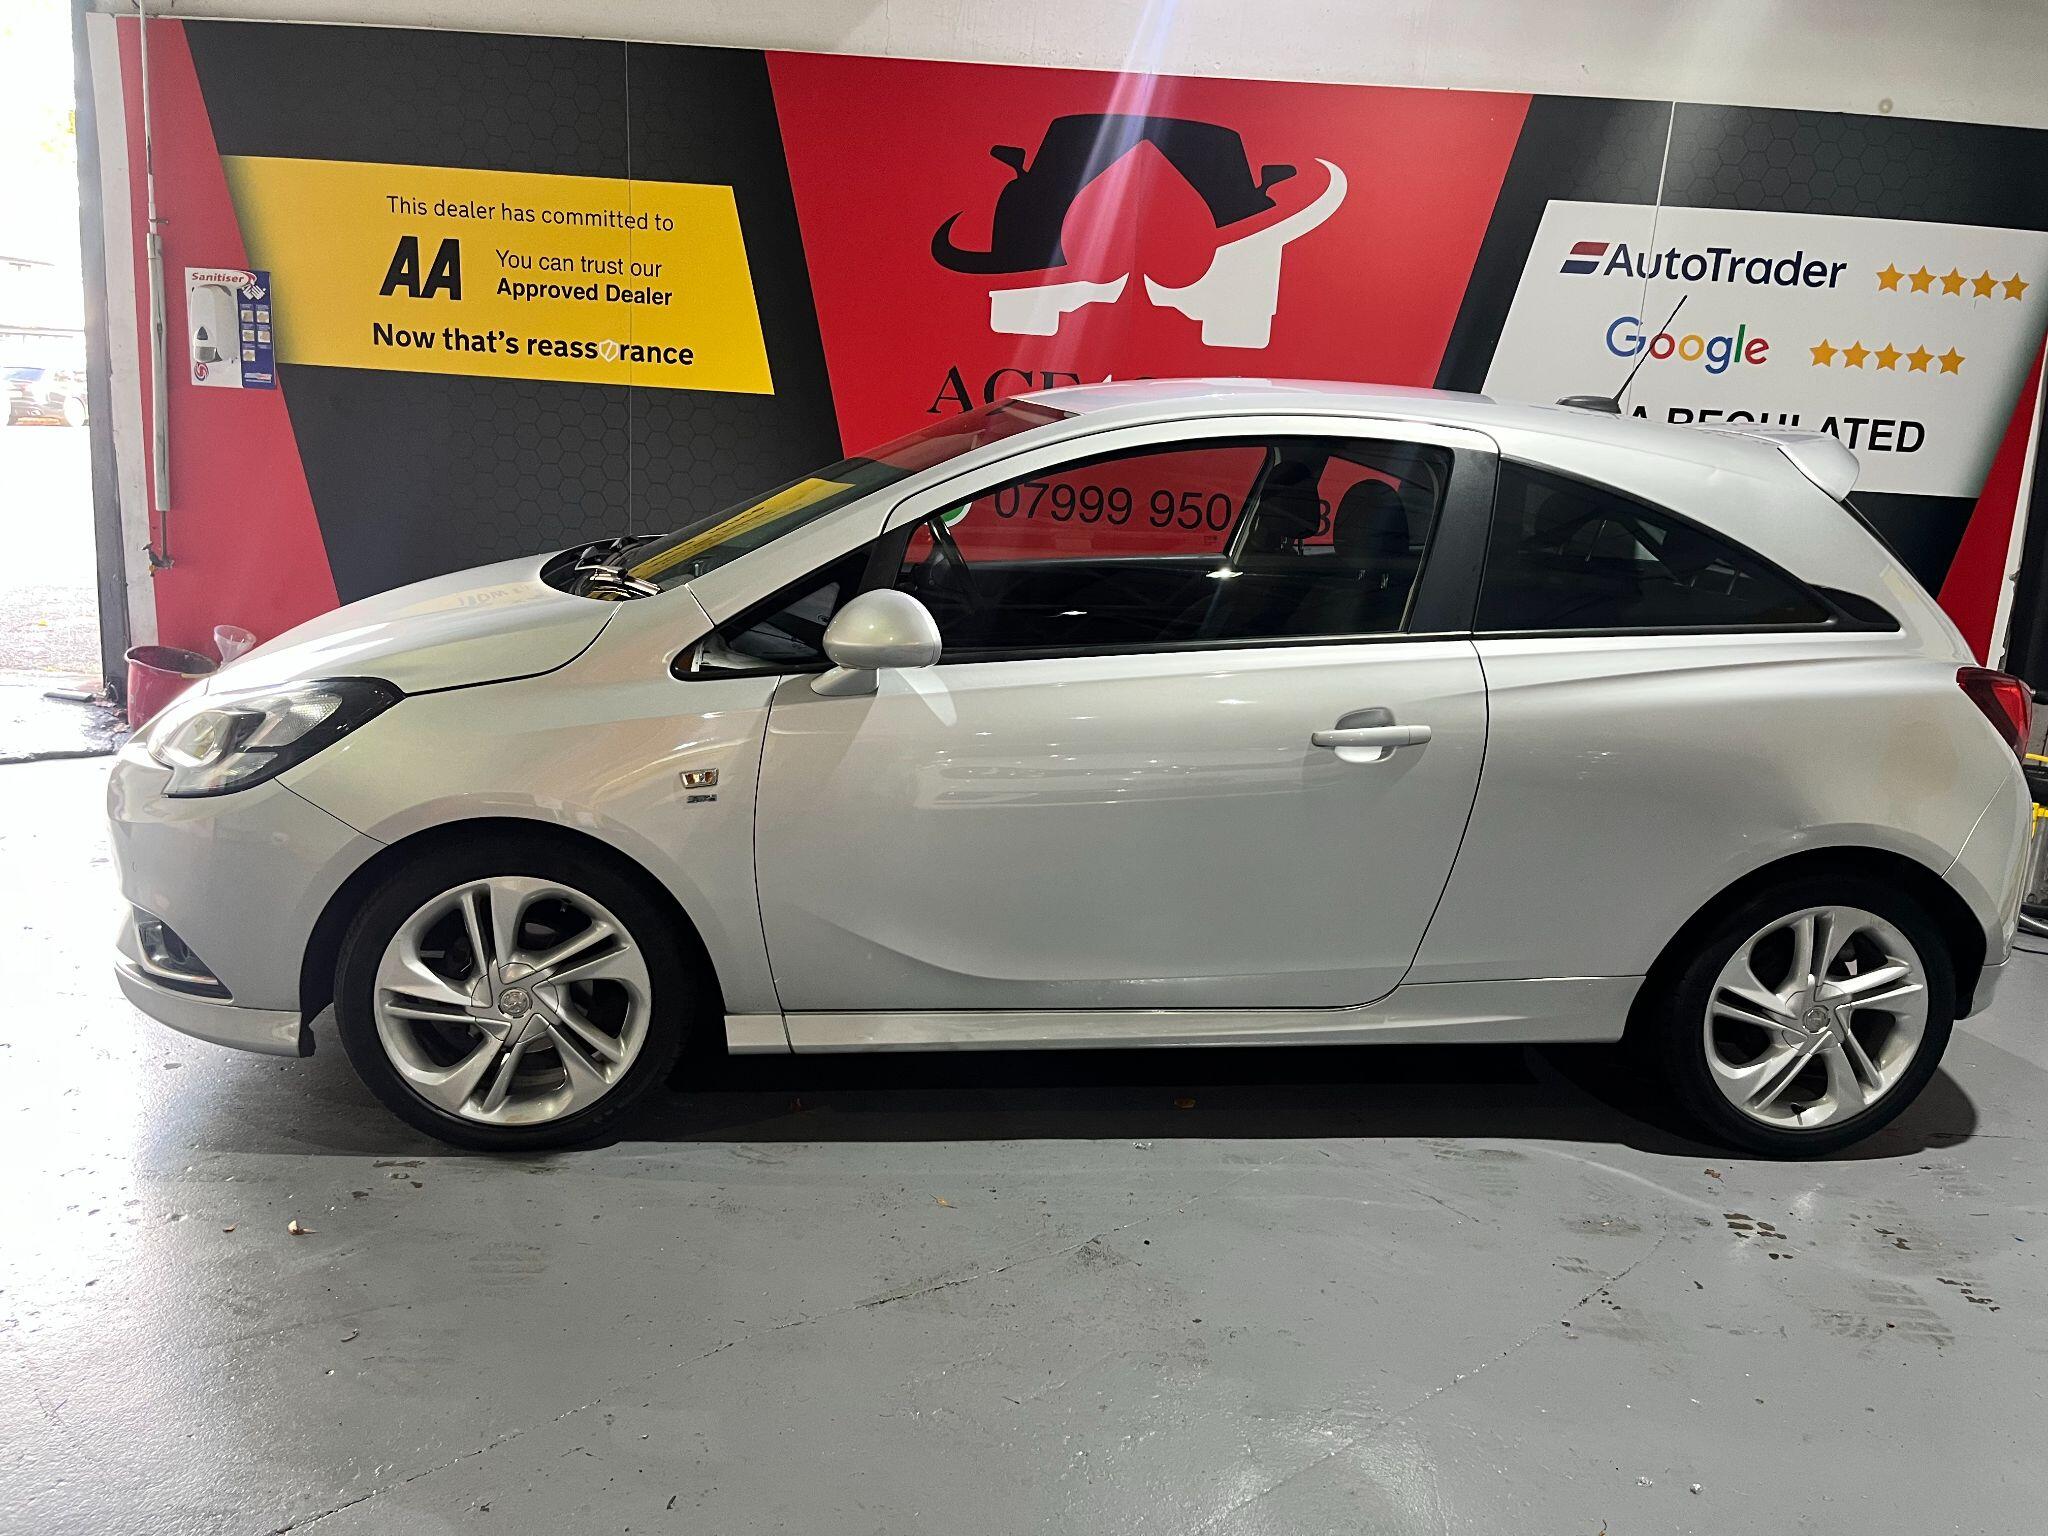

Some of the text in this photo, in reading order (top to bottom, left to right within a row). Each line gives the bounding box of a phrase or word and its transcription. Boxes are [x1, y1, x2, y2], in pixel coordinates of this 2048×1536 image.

[386, 195, 675, 232] This dealer has committed to
[191, 272, 244, 283] Sanitiser
[378, 235, 463, 301] AA
[495, 248, 662, 278] You can trust our
[1604, 243, 1848, 290] AutoTrader
[496, 276, 673, 306] Approved Dealer
[372, 322, 436, 349] Now
[442, 328, 519, 355] that's
[1605, 316, 1770, 375] Google
[994, 482, 1232, 532] 07999 950
